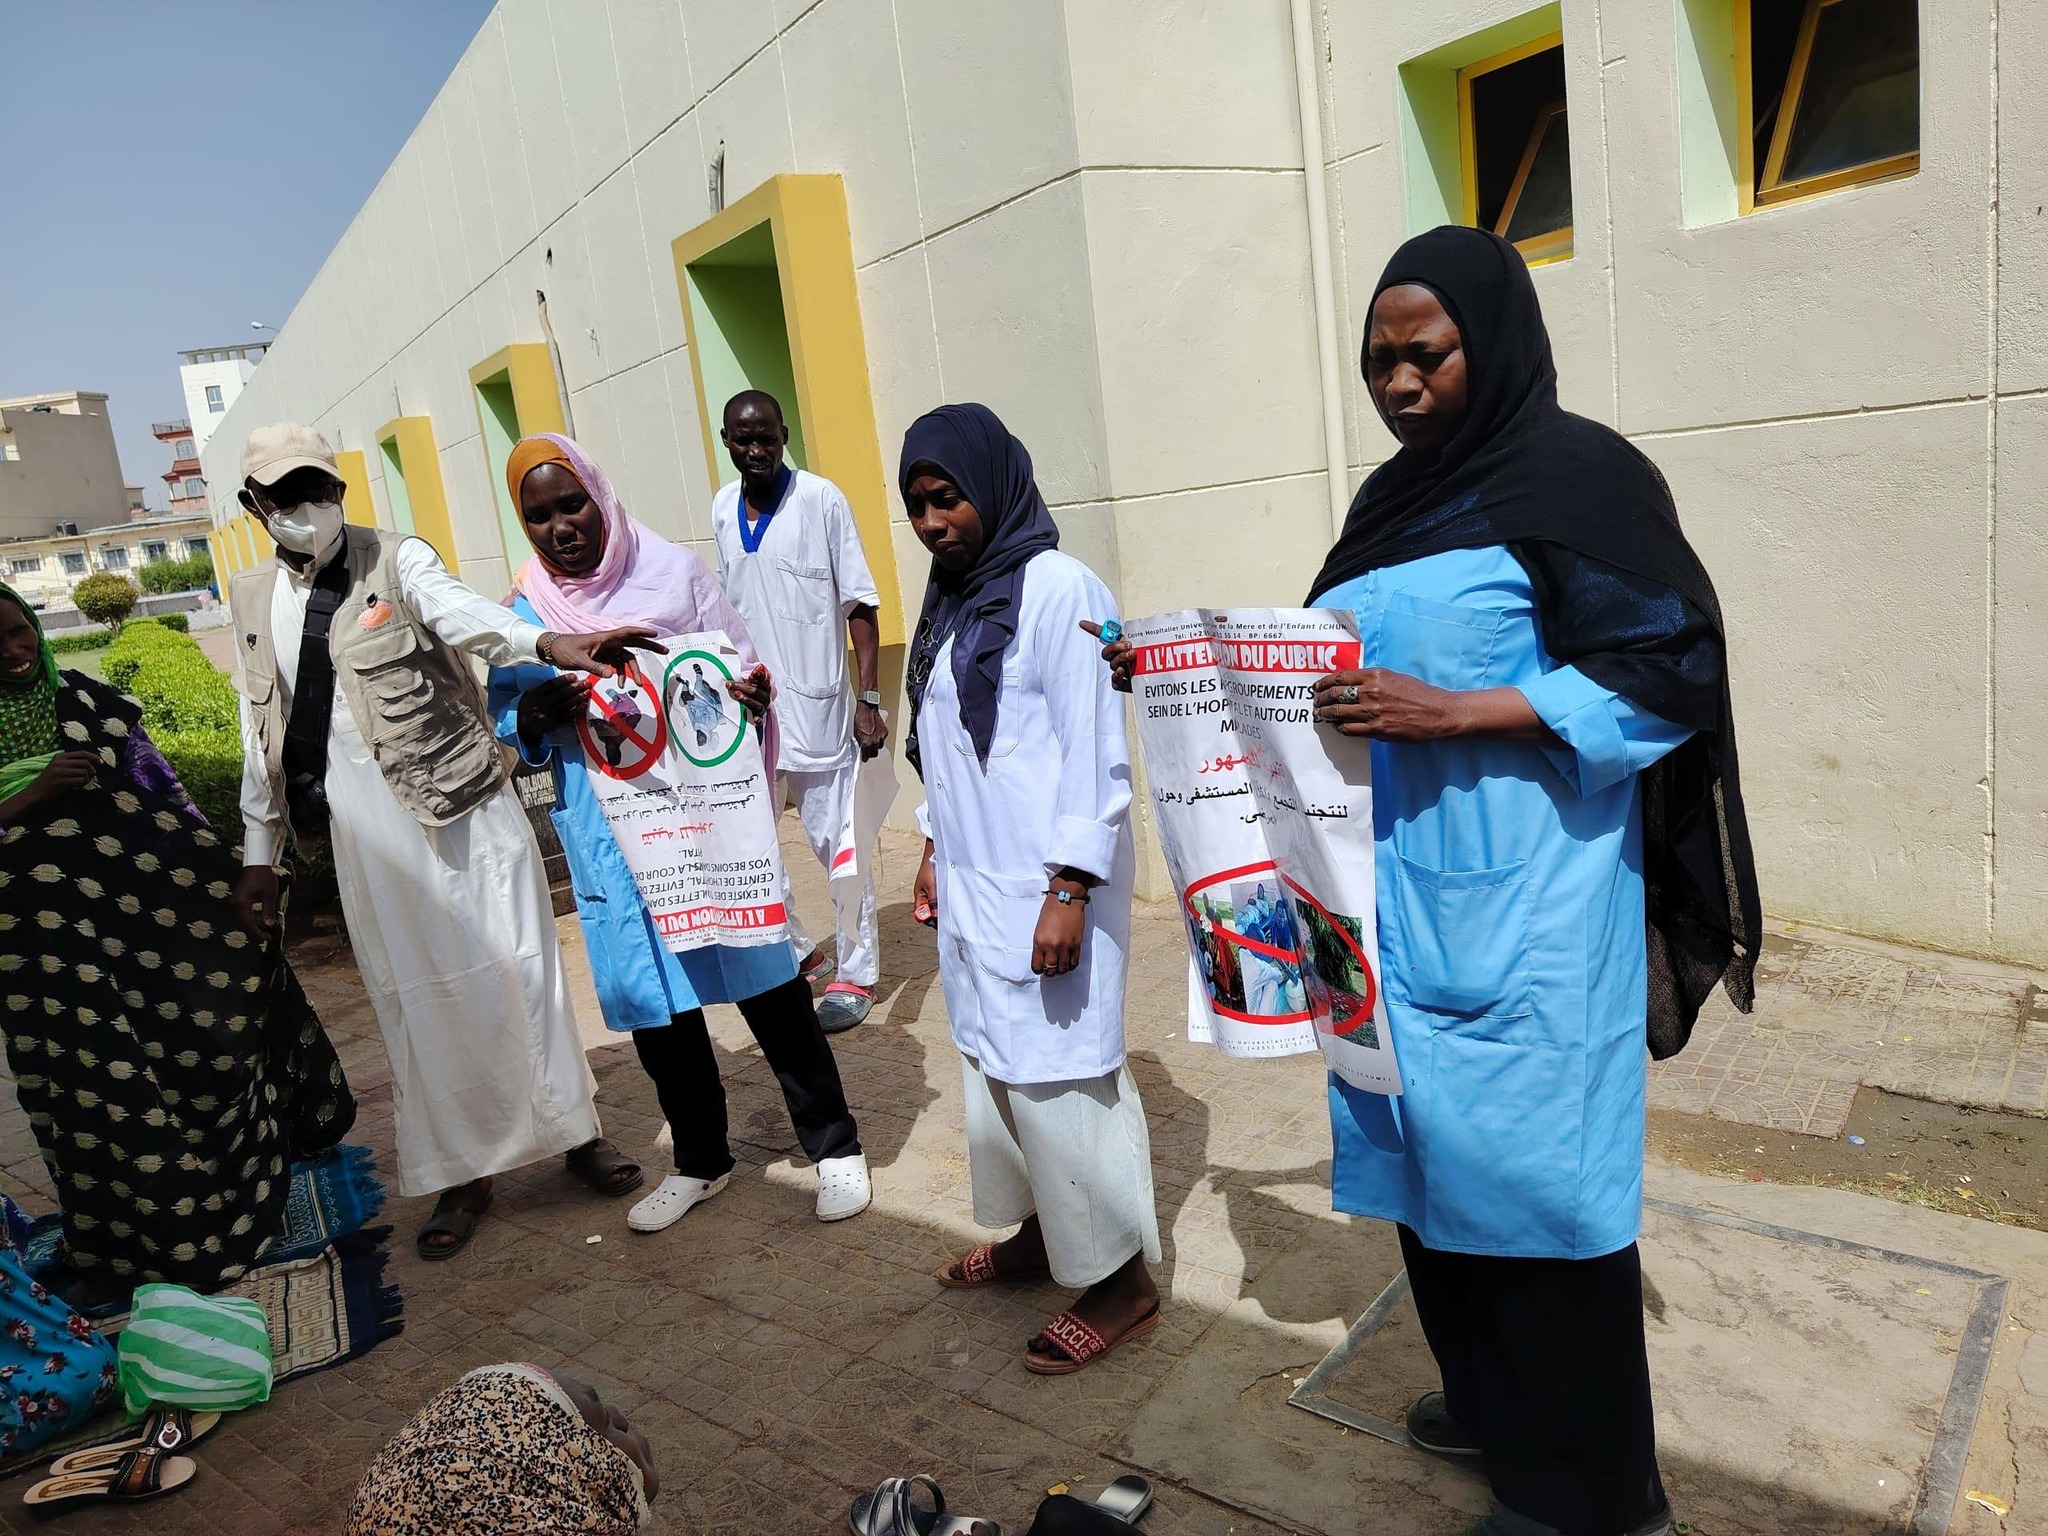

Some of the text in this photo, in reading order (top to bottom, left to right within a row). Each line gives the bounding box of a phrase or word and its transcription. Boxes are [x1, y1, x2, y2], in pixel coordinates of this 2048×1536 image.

[1145, 626, 1179, 635] Hospitalier
[1280, 622, 1315, 630] l'Enfant
[1145, 649, 1154, 671] A
[1240, 644, 1264, 668] DU
[1267, 644, 1337, 671] PUBLIC
[1145, 681, 1187, 698] EVITONS
[1190, 678, 1216, 694] LES
[1148, 705, 1169, 719] SEIN
[1170, 703, 1183, 717] DE
[1185, 698, 1243, 716] L'HOPTAL
[1243, 703, 1253, 717] ET
[1254, 706, 1309, 723] AUTOUR
[516, 769, 554, 793] LBORN
[710, 773, 759, 793] المستشفى
[533, 794, 557, 806] LITRES
[1157, 787, 1183, 804] وحول
[1186, 782, 1253, 805] المستشفى
[709, 794, 755, 812] المستشفى
[678, 863, 691, 874] LA
[711, 861, 746, 872] BESOINS
[748, 858, 771, 870] VOS
[646, 866, 675, 880] COUR
[737, 872, 774, 886] CEINTE
[649, 880, 684, 894] EVITEZ
[687, 876, 722, 887] L'HOPTAL,
[723, 877, 735, 887] DE
[668, 890, 713, 906] TLETTES
[728, 889, 758, 900] EXISTE
[760, 888, 770, 897] IL
[645, 897, 665, 908] DAN
[668, 913, 690, 931] DU
[755, 908, 765, 925] A
